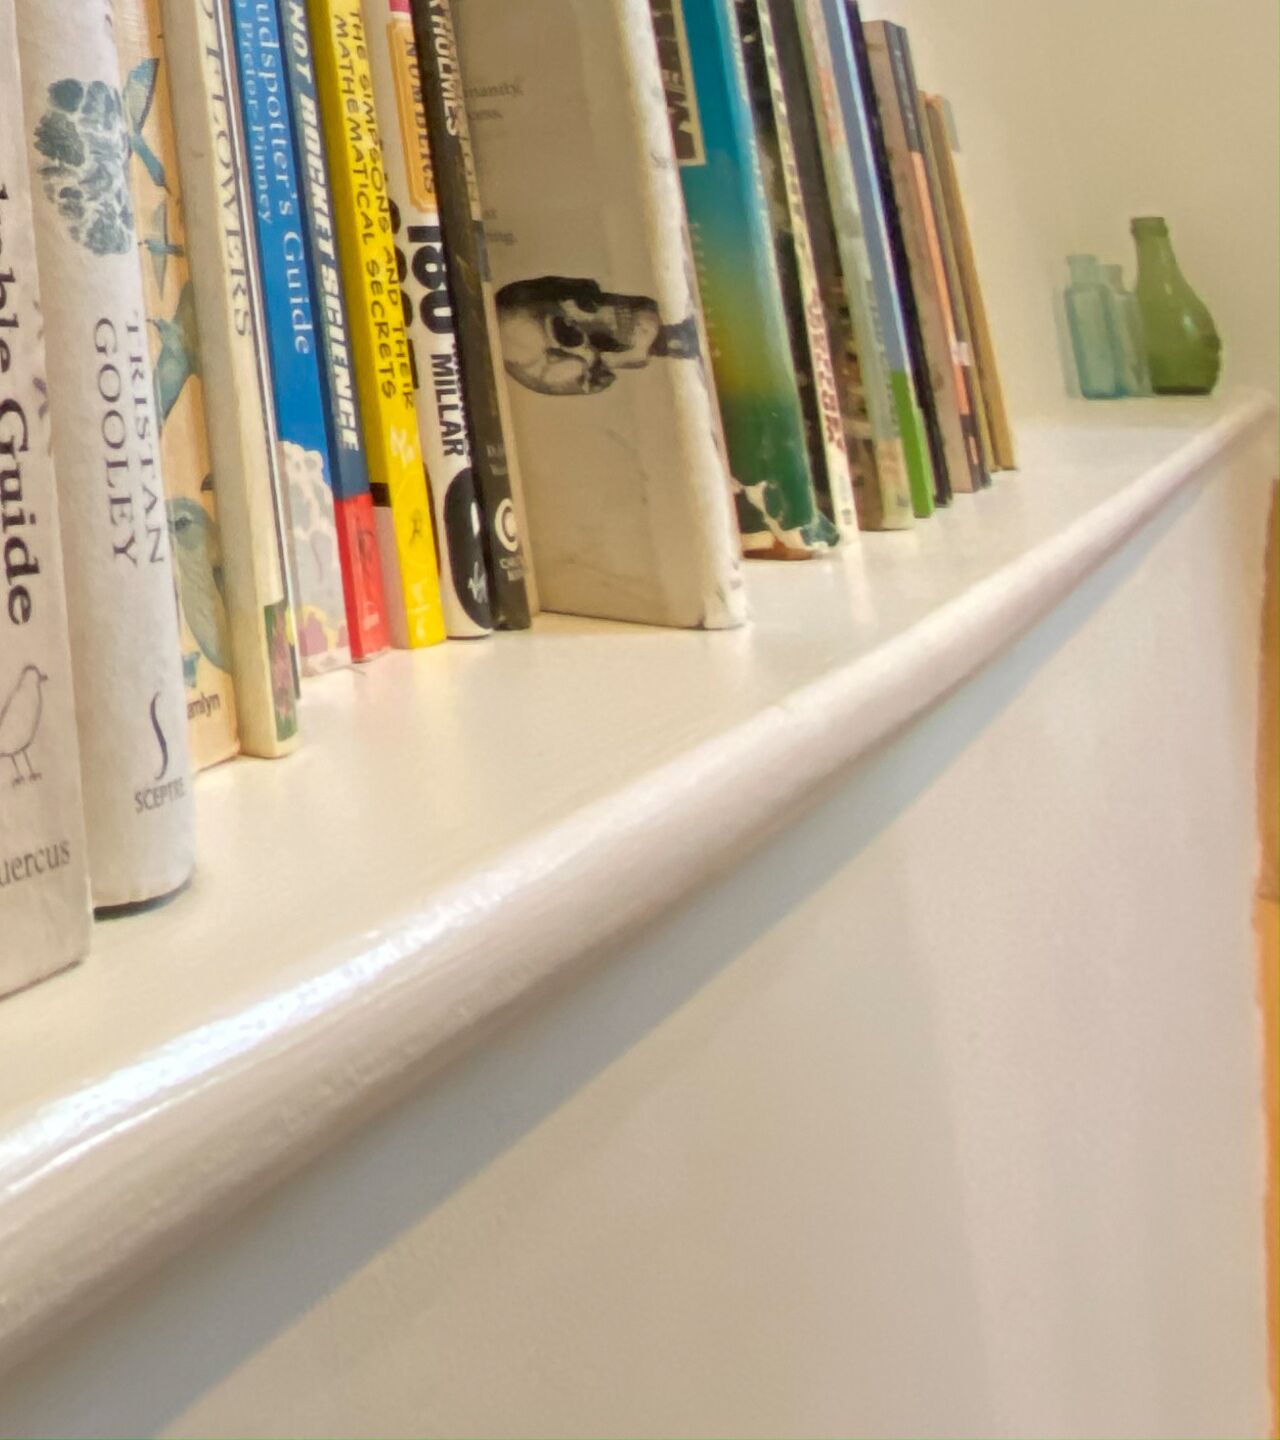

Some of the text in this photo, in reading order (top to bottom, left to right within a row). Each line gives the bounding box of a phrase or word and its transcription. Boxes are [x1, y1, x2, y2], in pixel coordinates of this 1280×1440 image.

[240, 22, 274, 225] Pretor-Pinney
[288, 5, 313, 86] NOT
[405, 38, 436, 195] NUMBERS
[428, 13, 463, 137] HOLMES
[206, 44, 251, 338] FLOWERS
[299, 91, 334, 260] ROCKET
[333, 14, 397, 400] MATHEMATICAL SECRETS
[349, 12, 367, 58] THE
[359, 73, 390, 233] SIMPSONS
[383, 246, 399, 306] AND
[391, 320, 415, 410] THEIR
[283, 231, 313, 356] Guide
[321, 263, 360, 453] SCIENCE
[94, 317, 138, 567] GOOLEY
[126, 308, 165, 564] TRISTAN
[430, 353, 465, 457] MILLAR
[186, 692, 221, 720] amlyn
[134, 776, 186, 814] SCEPTRE
